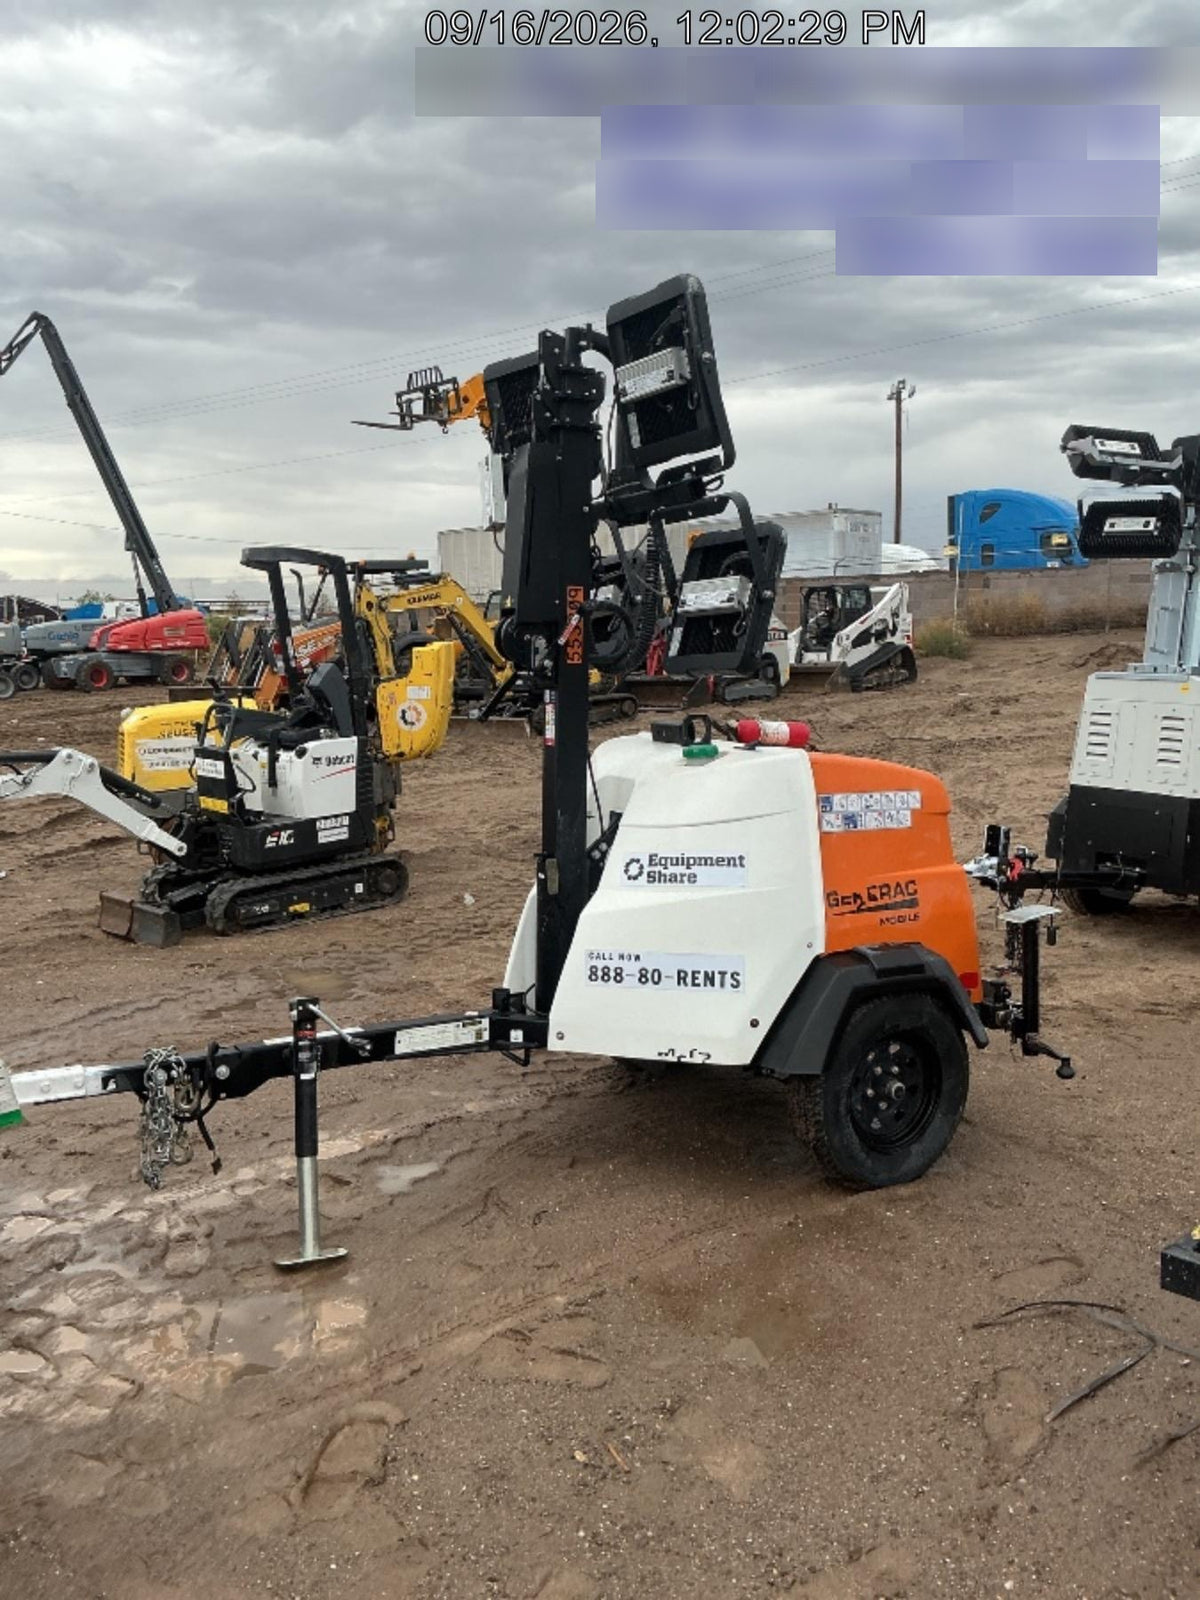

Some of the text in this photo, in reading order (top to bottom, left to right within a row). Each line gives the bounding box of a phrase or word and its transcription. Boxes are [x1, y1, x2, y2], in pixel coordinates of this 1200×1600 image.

[648, 853, 746, 870] Equipment
[646, 870, 698, 884] Share
[880, 912, 920, 926] MOBILE
[588, 952, 641, 962] CALL NOW
[588, 965, 742, 989] 888-80-RENTS
